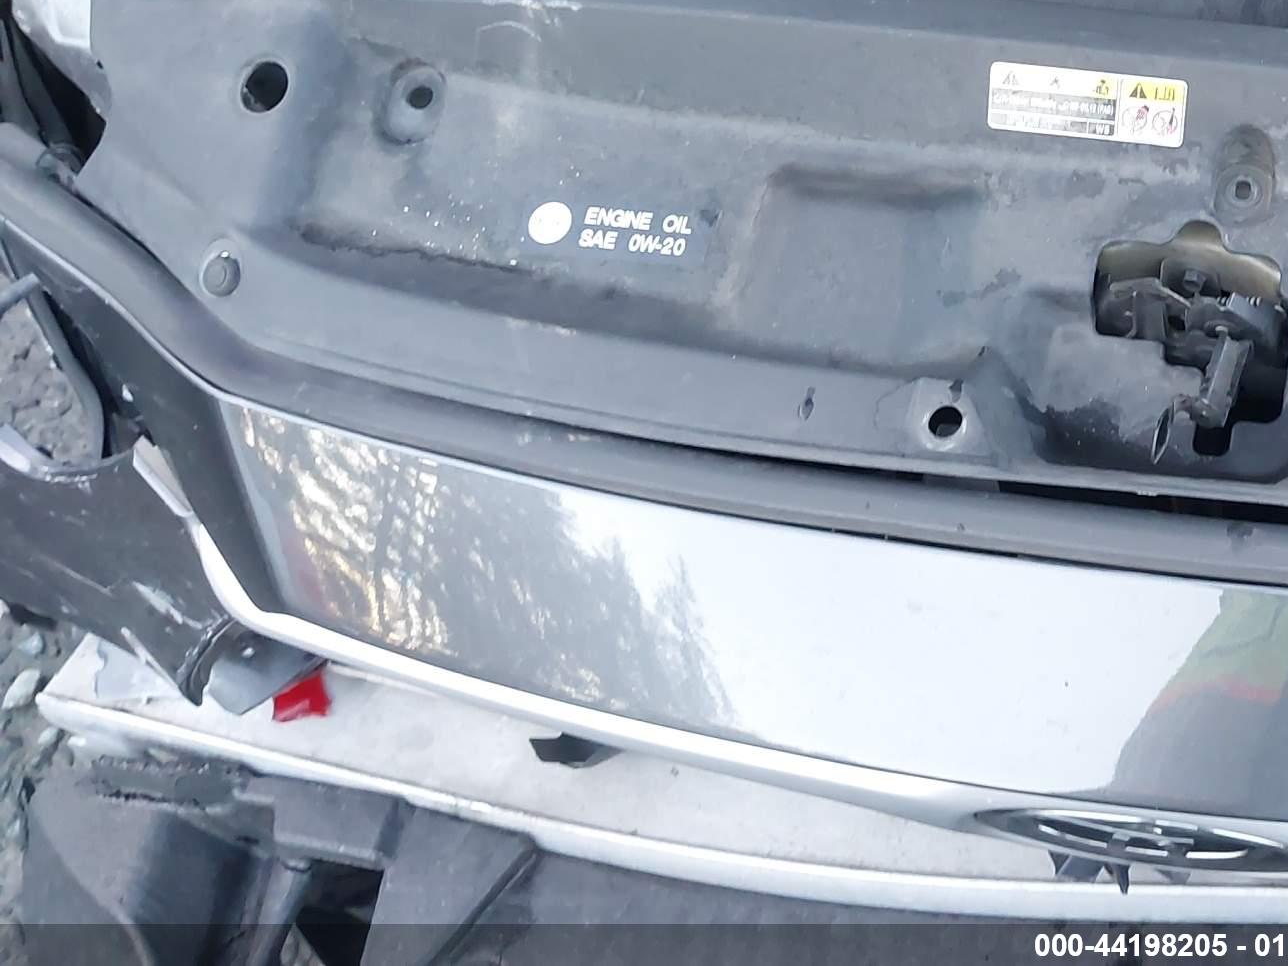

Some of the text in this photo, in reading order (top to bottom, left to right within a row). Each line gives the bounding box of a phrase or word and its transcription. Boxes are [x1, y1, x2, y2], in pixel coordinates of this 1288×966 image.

[584, 206, 692, 234] ENGINE OIL
[578, 229, 686, 256] SAE 0W-20
